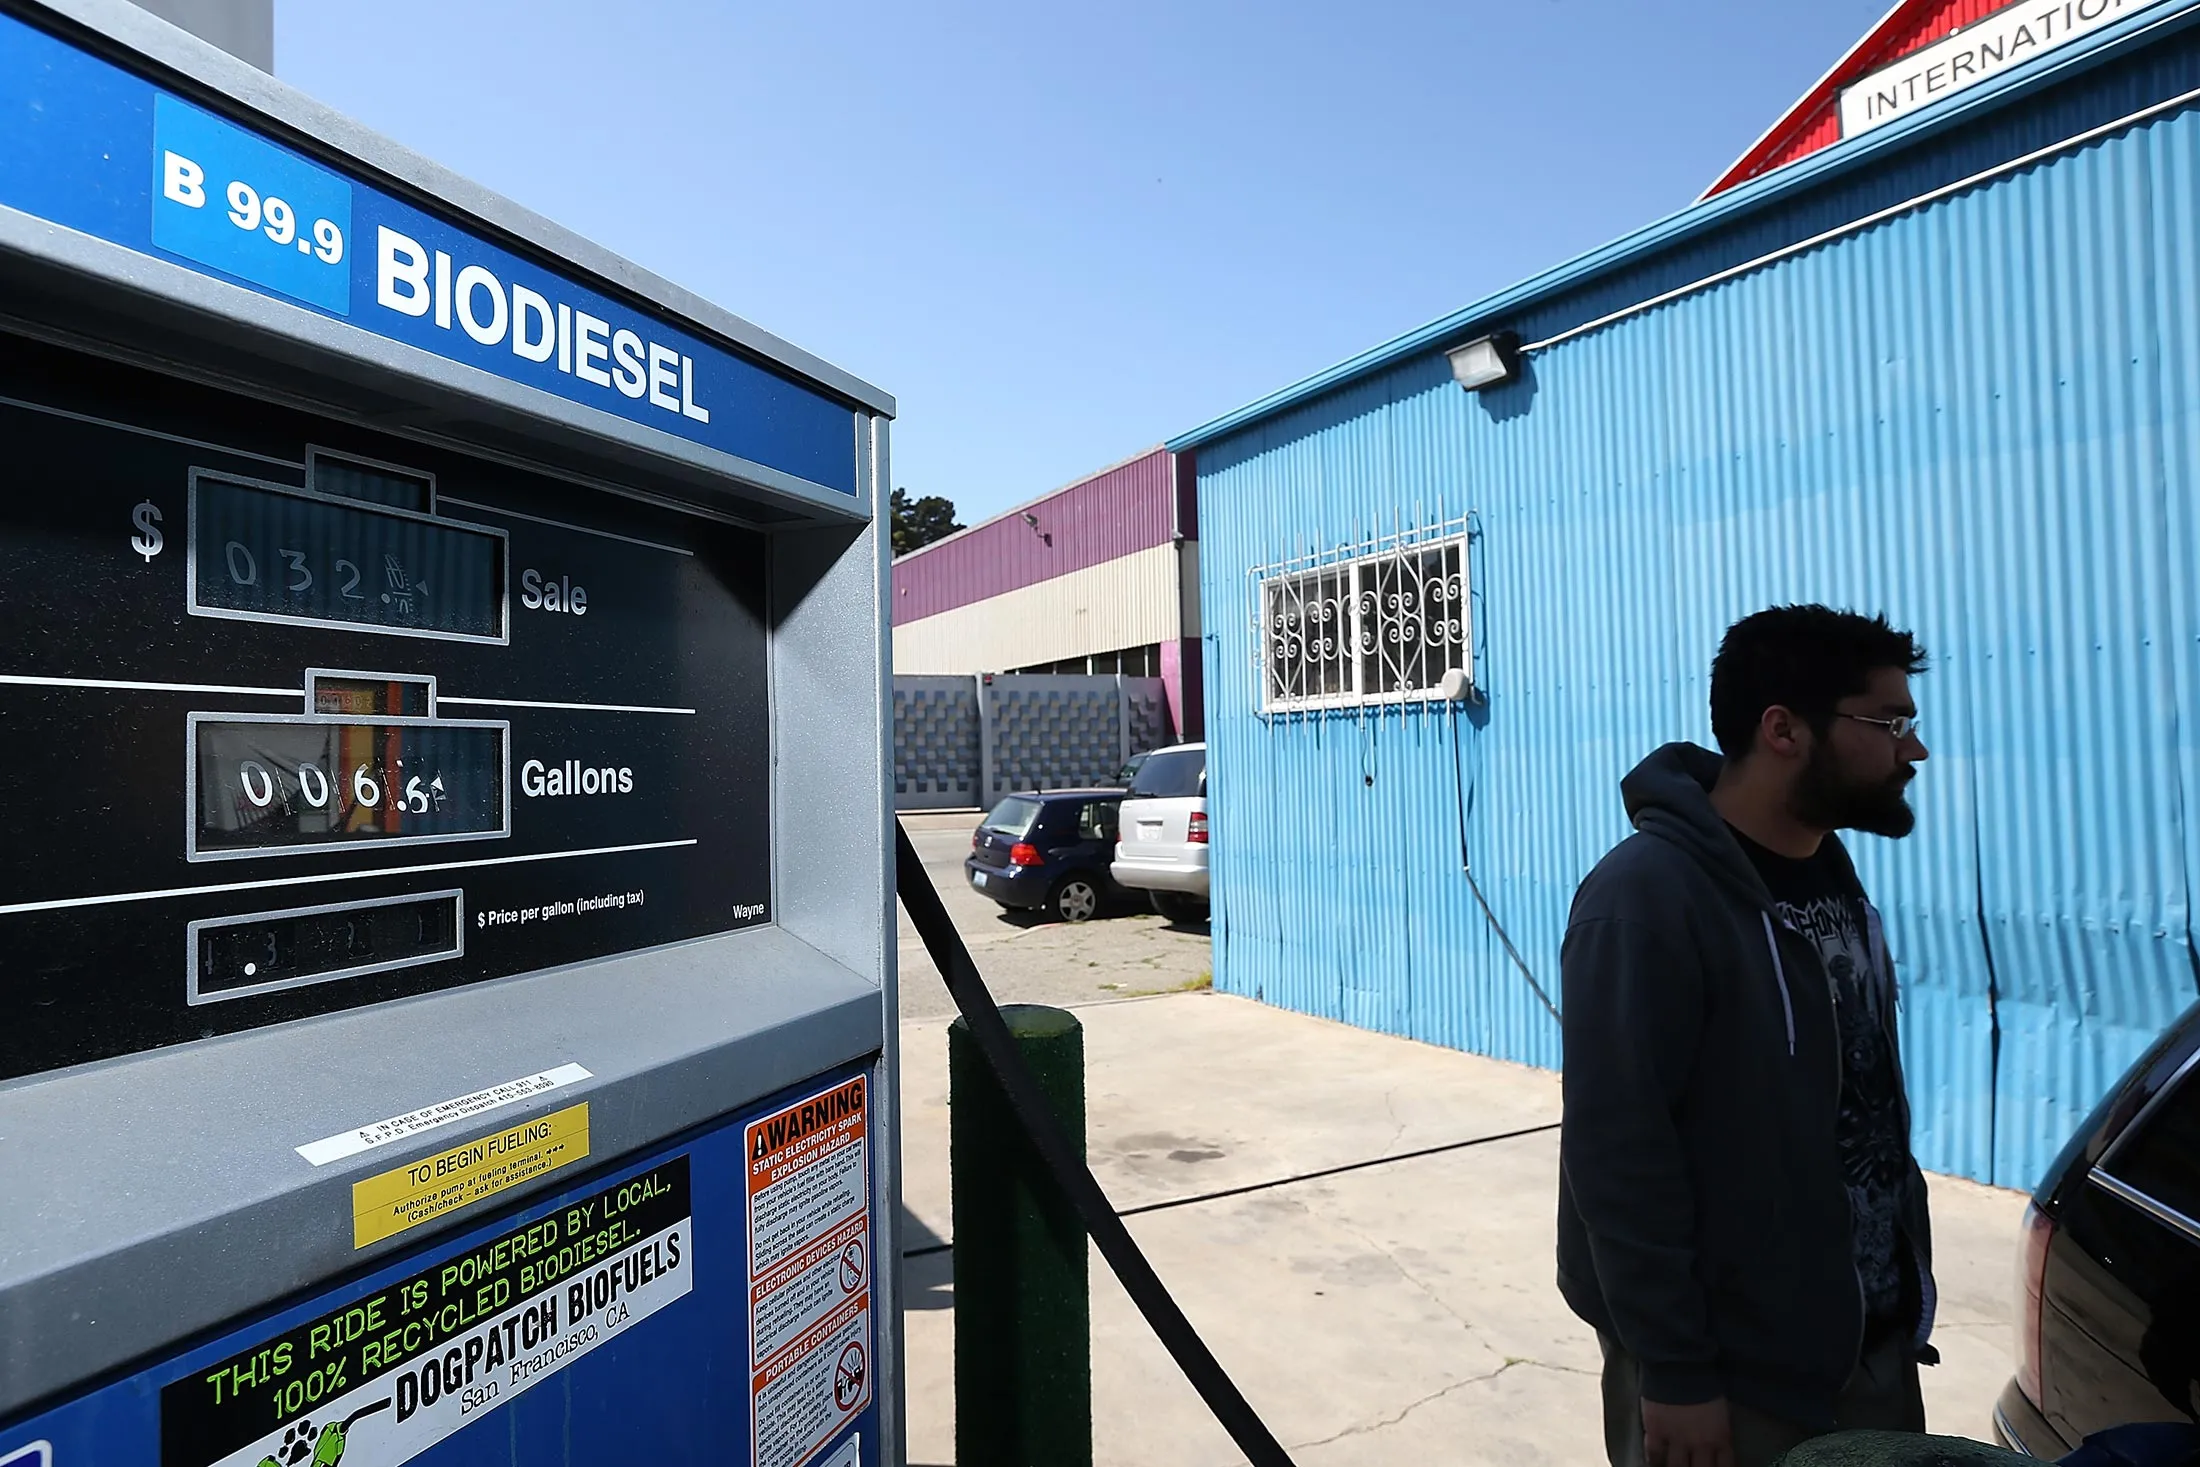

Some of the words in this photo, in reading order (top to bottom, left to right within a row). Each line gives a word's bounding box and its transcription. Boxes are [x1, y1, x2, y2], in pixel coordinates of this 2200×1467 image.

[1867, 0, 2121, 120] INTERNATIO
[164, 150, 206, 209] B
[226, 180, 344, 265] 99.9
[377, 224, 709, 423] BIODIESEL
[131, 499, 163, 562] $
[522, 569, 587, 615] Sale
[521, 759, 634, 797] Gallons
[478, 914, 486, 928] $
[488, 909, 518, 926] Price
[520, 909, 538, 924] per
[541, 902, 574, 921] gallon
[577, 893, 625, 916] (including
[626, 889, 644, 906] tax)
[733, 904, 765, 921] Wayne
[391, 1115, 419, 1127] CASE
[420, 1110, 432, 1118] OF
[435, 1093, 491, 1113] EMERGENCY
[493, 1086, 516, 1095] CALL
[408, 1112, 459, 1130] Emergency
[459, 1100, 497, 1114] Dispatch
[768, 1084, 862, 1150] WARNING
[408, 1165, 431, 1186] TO
[437, 1145, 483, 1177] BEGIN
[489, 1123, 552, 1157] FUELING:
[753, 1151, 783, 1175] STATIC
[786, 1125, 836, 1159] ELECTRICITY
[838, 1112, 862, 1132] SPARK
[772, 1149, 818, 1181] EXPLOSION
[820, 1132, 850, 1156] HAZARD
[393, 1193, 438, 1216] Authorize
[441, 1183, 465, 1198] pump
[467, 1177, 476, 1187] at
[479, 1166, 507, 1182] fueling
[510, 1151, 543, 1170] terminal.
[408, 1193, 463, 1222] (Cash/check
[475, 1183, 489, 1195] ask
[491, 1178, 503, 1189] for
[506, 1158, 552, 1183] assistance.)
[207, 1342, 294, 1404] THIS
[310, 1296, 386, 1359] RIDE
[401, 1280, 428, 1315] IS
[441, 1220, 558, 1296] POWERED
[567, 1202, 595, 1236] BY
[604, 1174, 672, 1219] LOCAL,
[756, 1259, 804, 1299] ELECTRONIC
[806, 1238, 836, 1266] DEVICES
[837, 1220, 863, 1245] HAZARD
[273, 1356, 347, 1419] 100%
[362, 1282, 510, 1375] RECYCLED
[520, 1220, 641, 1294] BIODIESEL.
[396, 1294, 558, 1425] DOGPATCH
[567, 1231, 681, 1327] BIOFUELS
[766, 1340, 809, 1381] PORTABLE
[811, 1303, 858, 1345] CONTAINERS
[461, 1380, 500, 1416] San
[510, 1324, 599, 1387] Francisco,
[605, 1302, 630, 1329] CA
